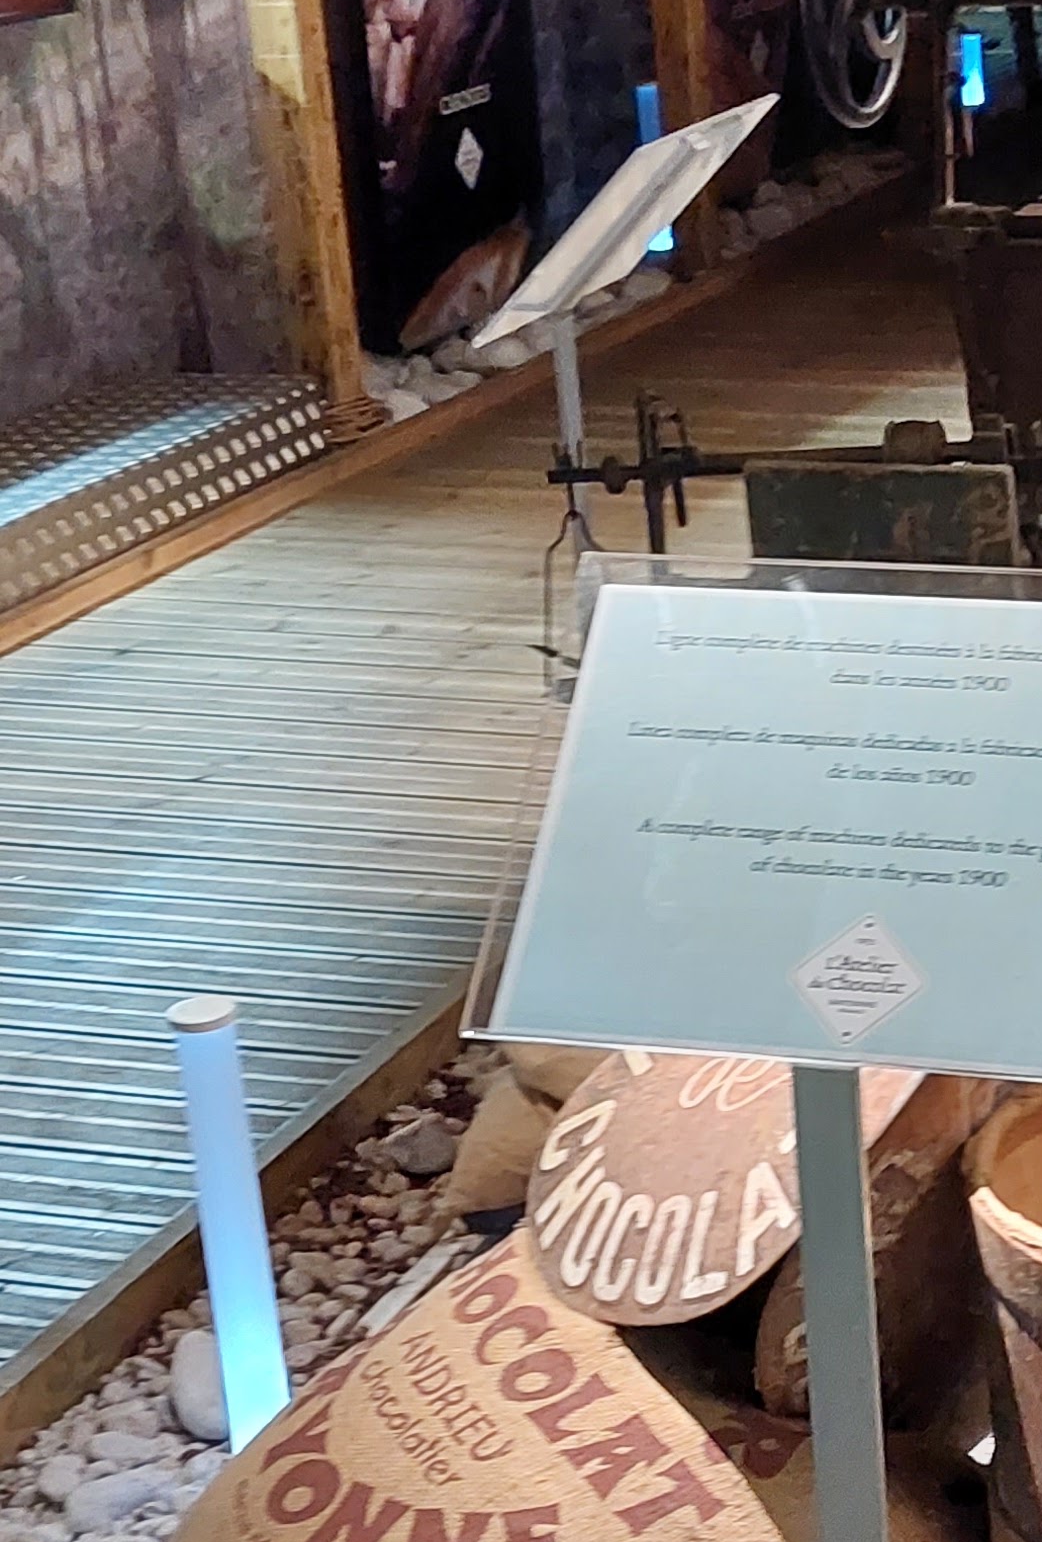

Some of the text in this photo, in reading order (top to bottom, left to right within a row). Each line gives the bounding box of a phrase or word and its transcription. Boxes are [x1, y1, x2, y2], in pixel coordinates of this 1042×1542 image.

[655, 630, 703, 651] Ligne
[781, 635, 804, 652] de
[804, 637, 883, 655] machines
[978, 643, 995, 660] la
[829, 668, 871, 685] dans
[873, 669, 897, 687] les
[960, 675, 1011, 692] 1900
[674, 724, 752, 747] completa
[753, 726, 776, 744] de
[860, 732, 944, 753] dedicadas
[945, 742, 957, 754] a
[959, 737, 977, 755] la
[826, 762, 976, 787] de los años 1900
[636, 818, 653, 832] A
[655, 820, 735, 842] complete
[735, 827, 783, 846] range
[784, 825, 811, 841] of
[807, 828, 888, 847] machines
[984, 842, 1004, 854] to
[1006, 838, 1036, 856] the
[749, 856, 1009, 889] of chocolate in the years 1900
[534, 1098, 799, 1306] CHOCOLA
